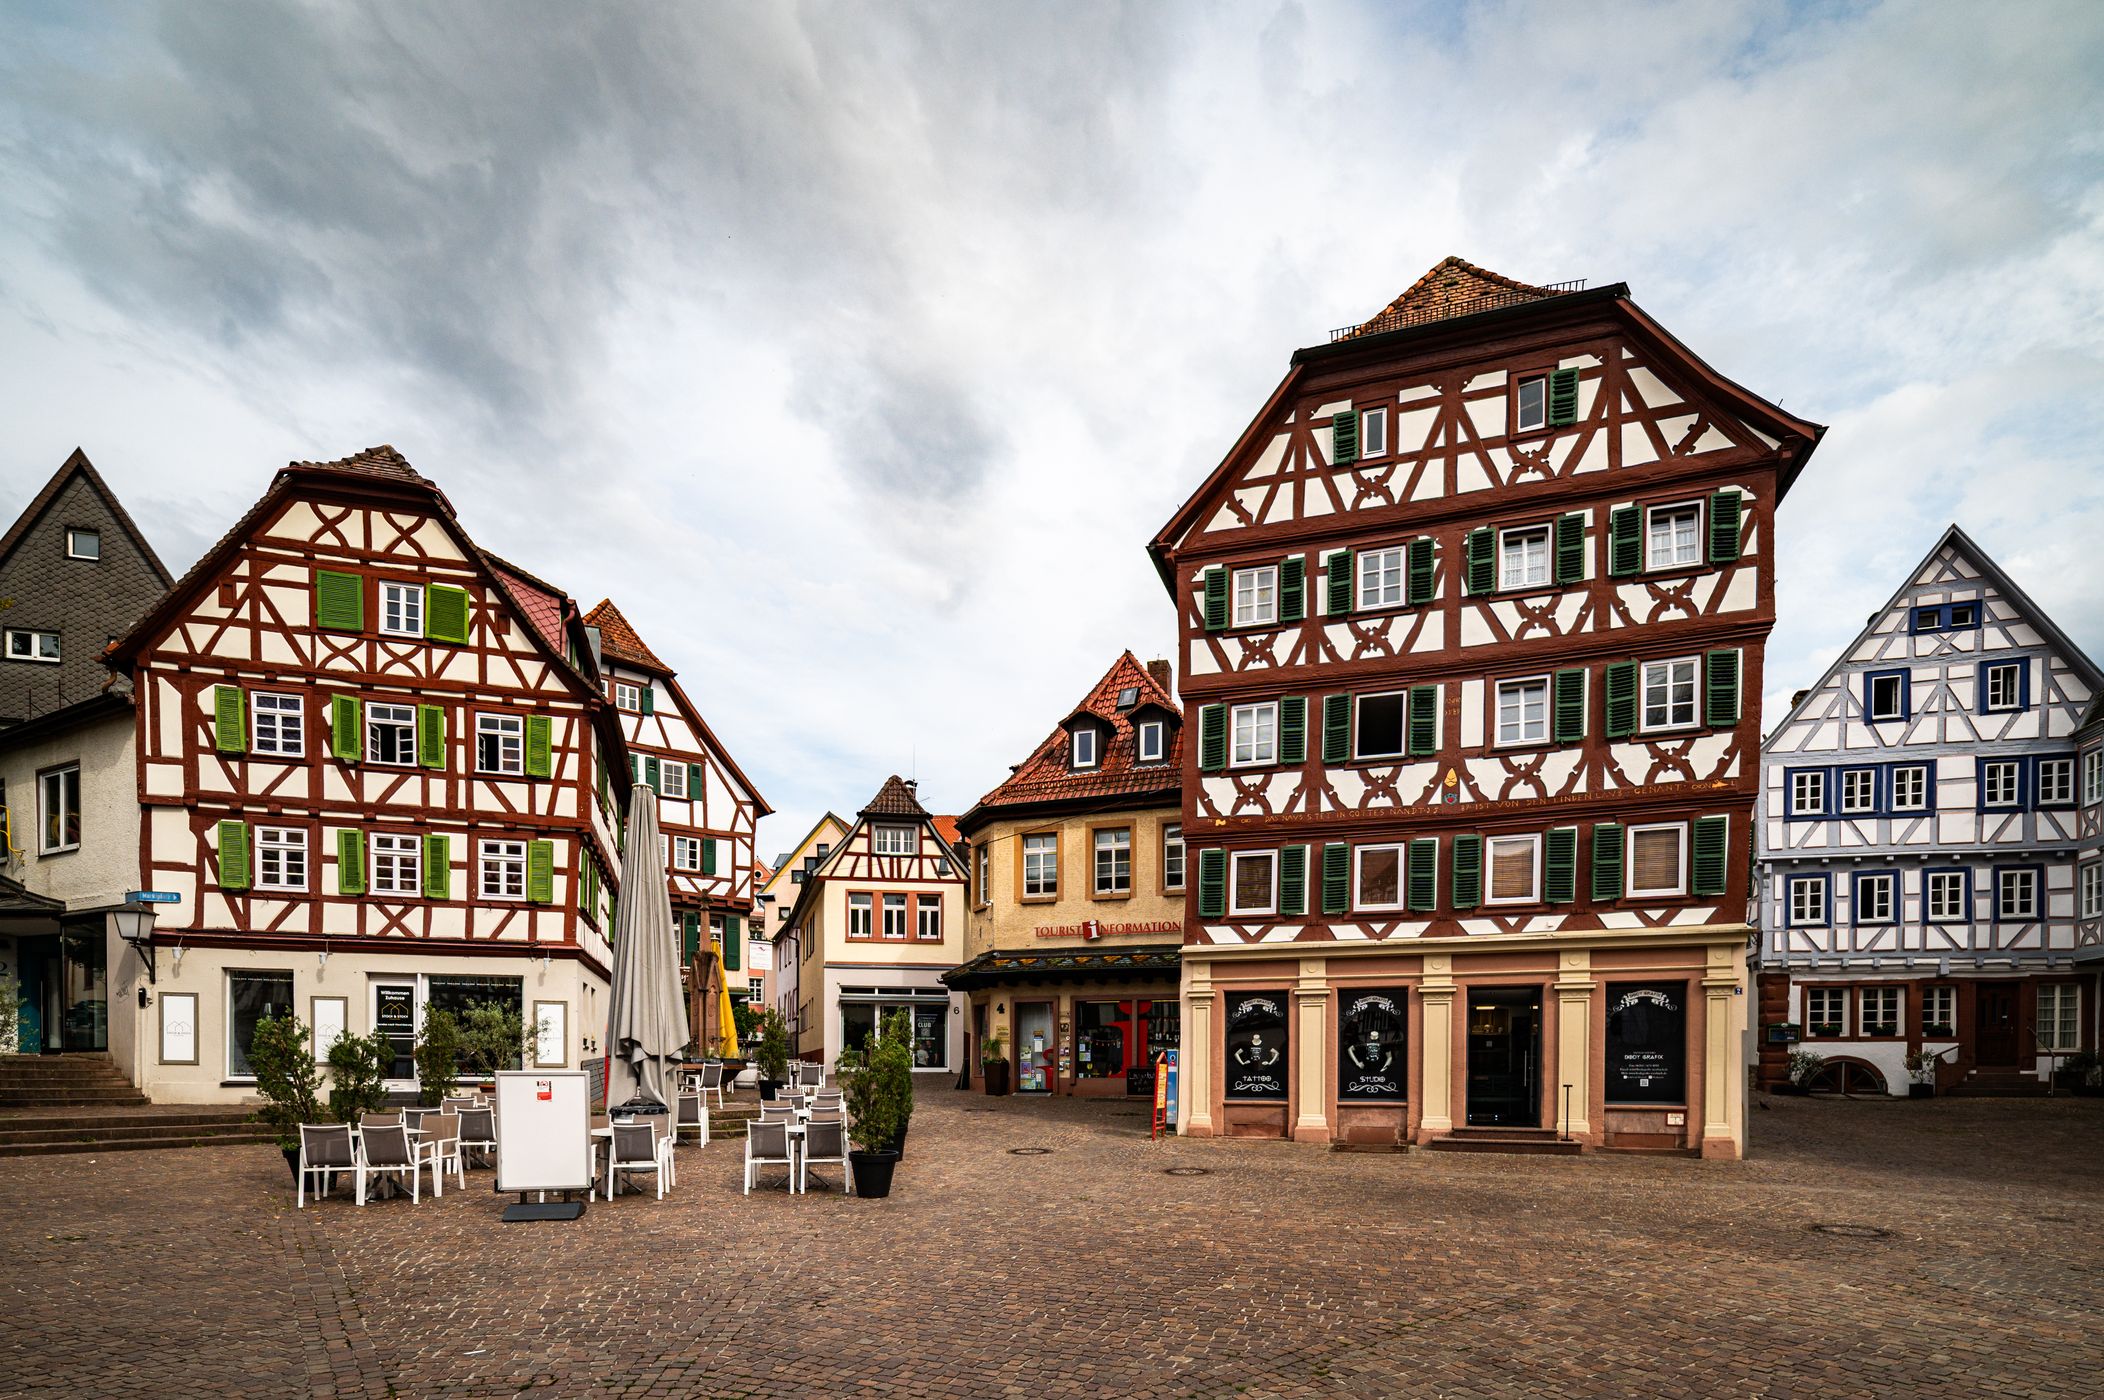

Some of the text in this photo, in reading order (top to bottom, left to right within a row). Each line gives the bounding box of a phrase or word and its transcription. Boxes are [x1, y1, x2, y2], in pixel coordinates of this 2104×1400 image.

[1496, 800, 1519, 808] VON
[1034, 925, 1082, 937] TOURIST
[953, 1006, 960, 1015] 6
[996, 1003, 1005, 1014] 4
[1359, 1075, 1386, 1083] STUDIO
